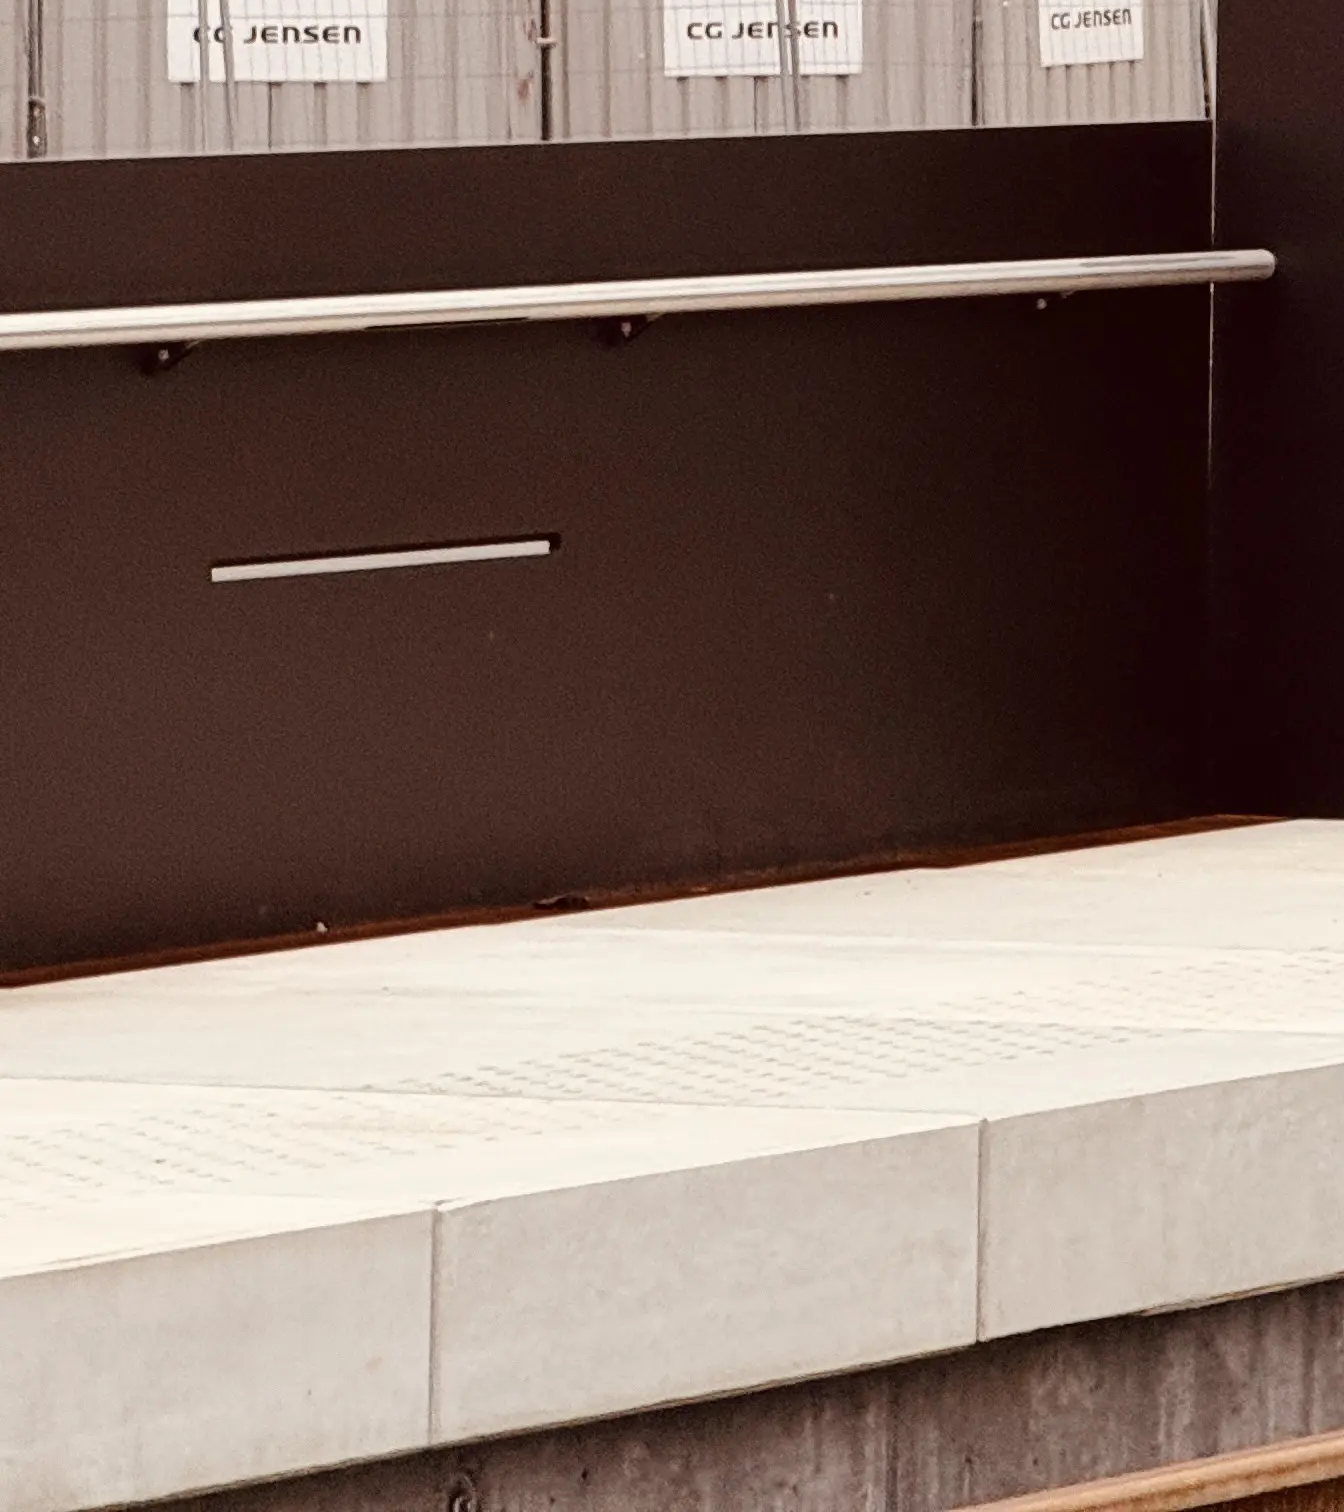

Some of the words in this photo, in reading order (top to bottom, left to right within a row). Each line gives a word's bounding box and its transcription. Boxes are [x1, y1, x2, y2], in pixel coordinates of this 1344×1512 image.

[1051, 12, 1070, 30] CG
[1074, 8, 1132, 29] JENSEN
[243, 25, 361, 44] JENSEN
[687, 22, 723, 40] CG
